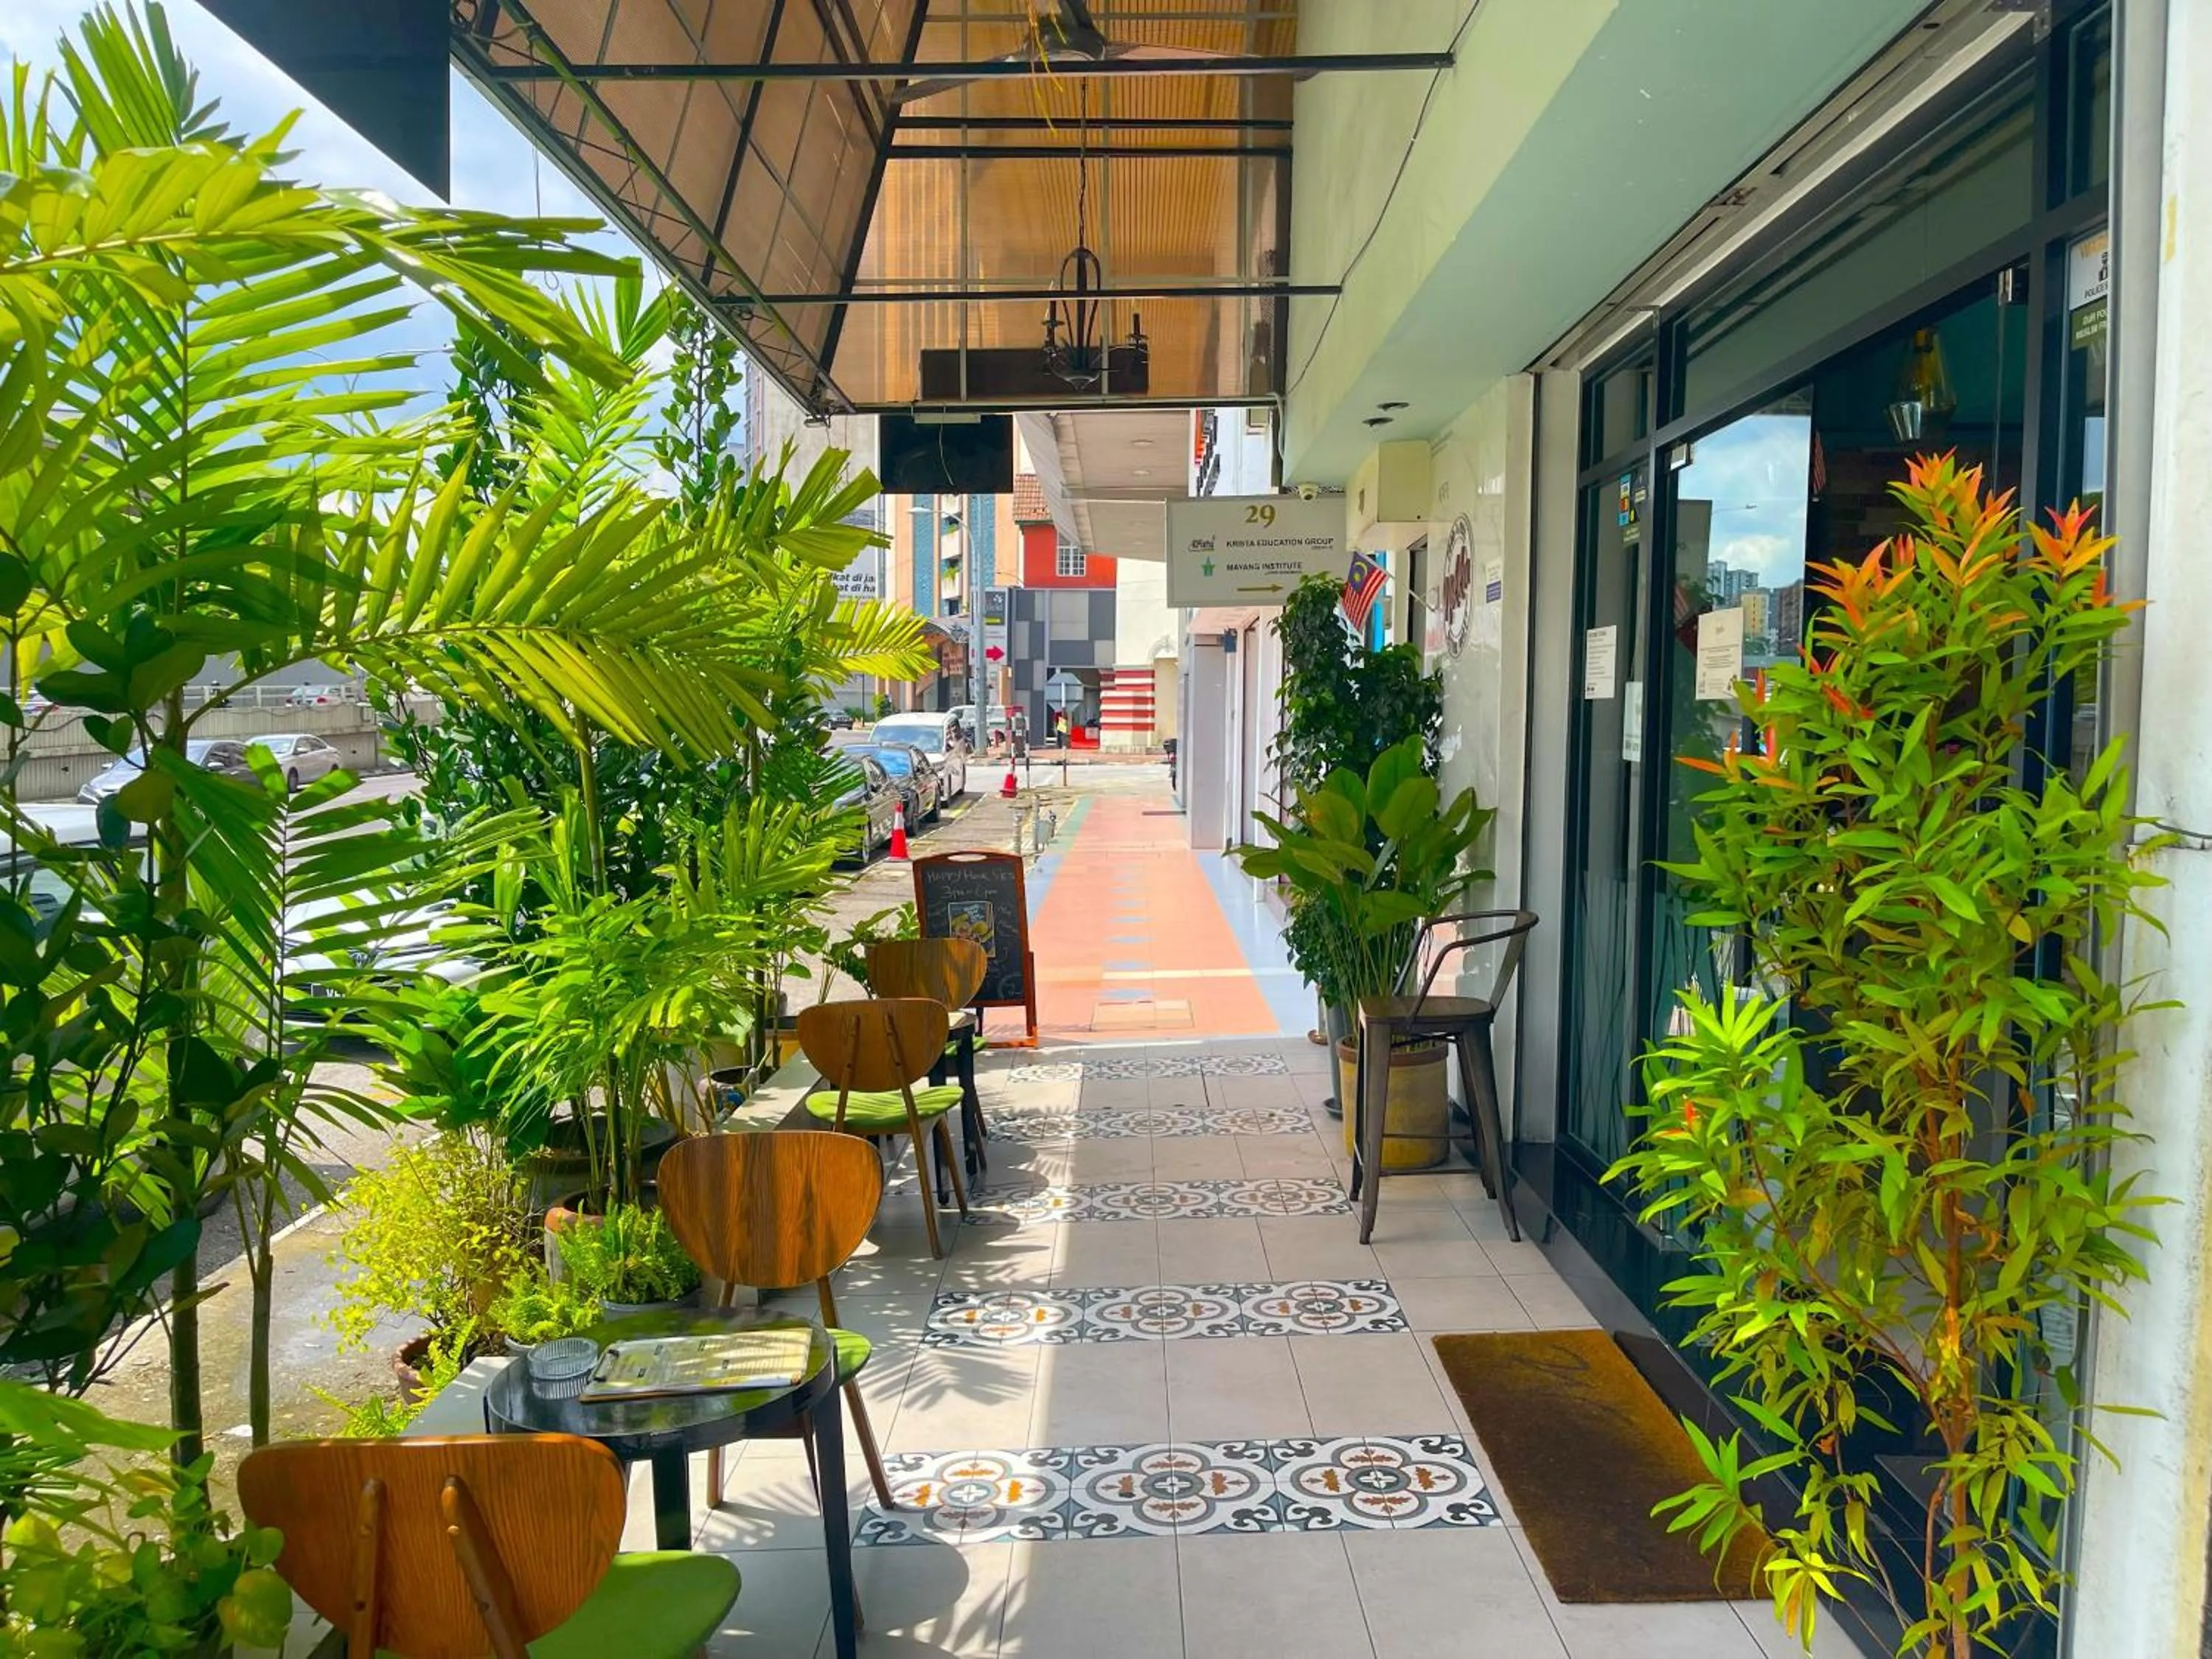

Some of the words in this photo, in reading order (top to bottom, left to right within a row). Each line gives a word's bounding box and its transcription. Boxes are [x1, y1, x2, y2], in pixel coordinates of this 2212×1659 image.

[1245, 504, 1276, 529] 29
[1226, 539, 1254, 548] KRISTA
[1256, 538, 1303, 547] EDUCATION
[1304, 538, 1334, 546] GROUP
[1226, 563, 1260, 571] MAYANG
[1262, 561, 1303, 570] INSTITUTE
